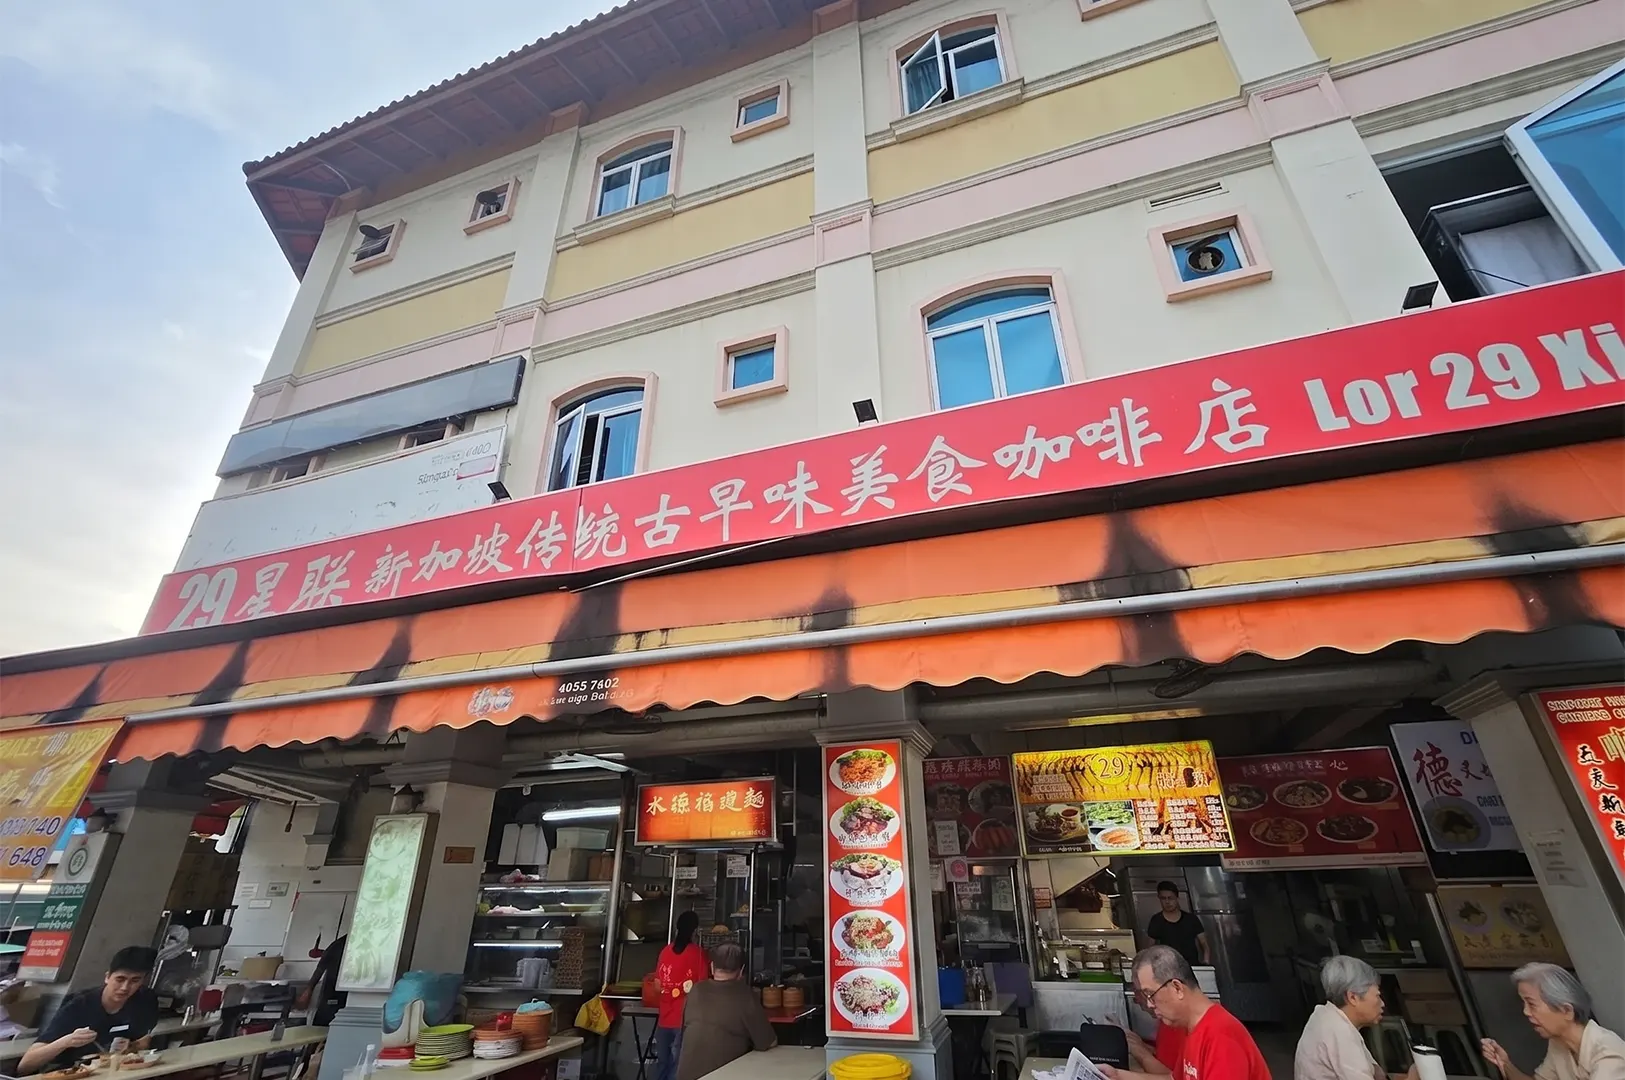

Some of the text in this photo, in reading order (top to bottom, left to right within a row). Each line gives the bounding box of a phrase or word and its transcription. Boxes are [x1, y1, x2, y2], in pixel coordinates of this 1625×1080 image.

[1303, 369, 1422, 433] Lor
[1429, 343, 1541, 411] 29
[1098, 757, 1125, 779] 29
[1413, 741, 1463, 798] 德
[9, 847, 46, 867] 648
